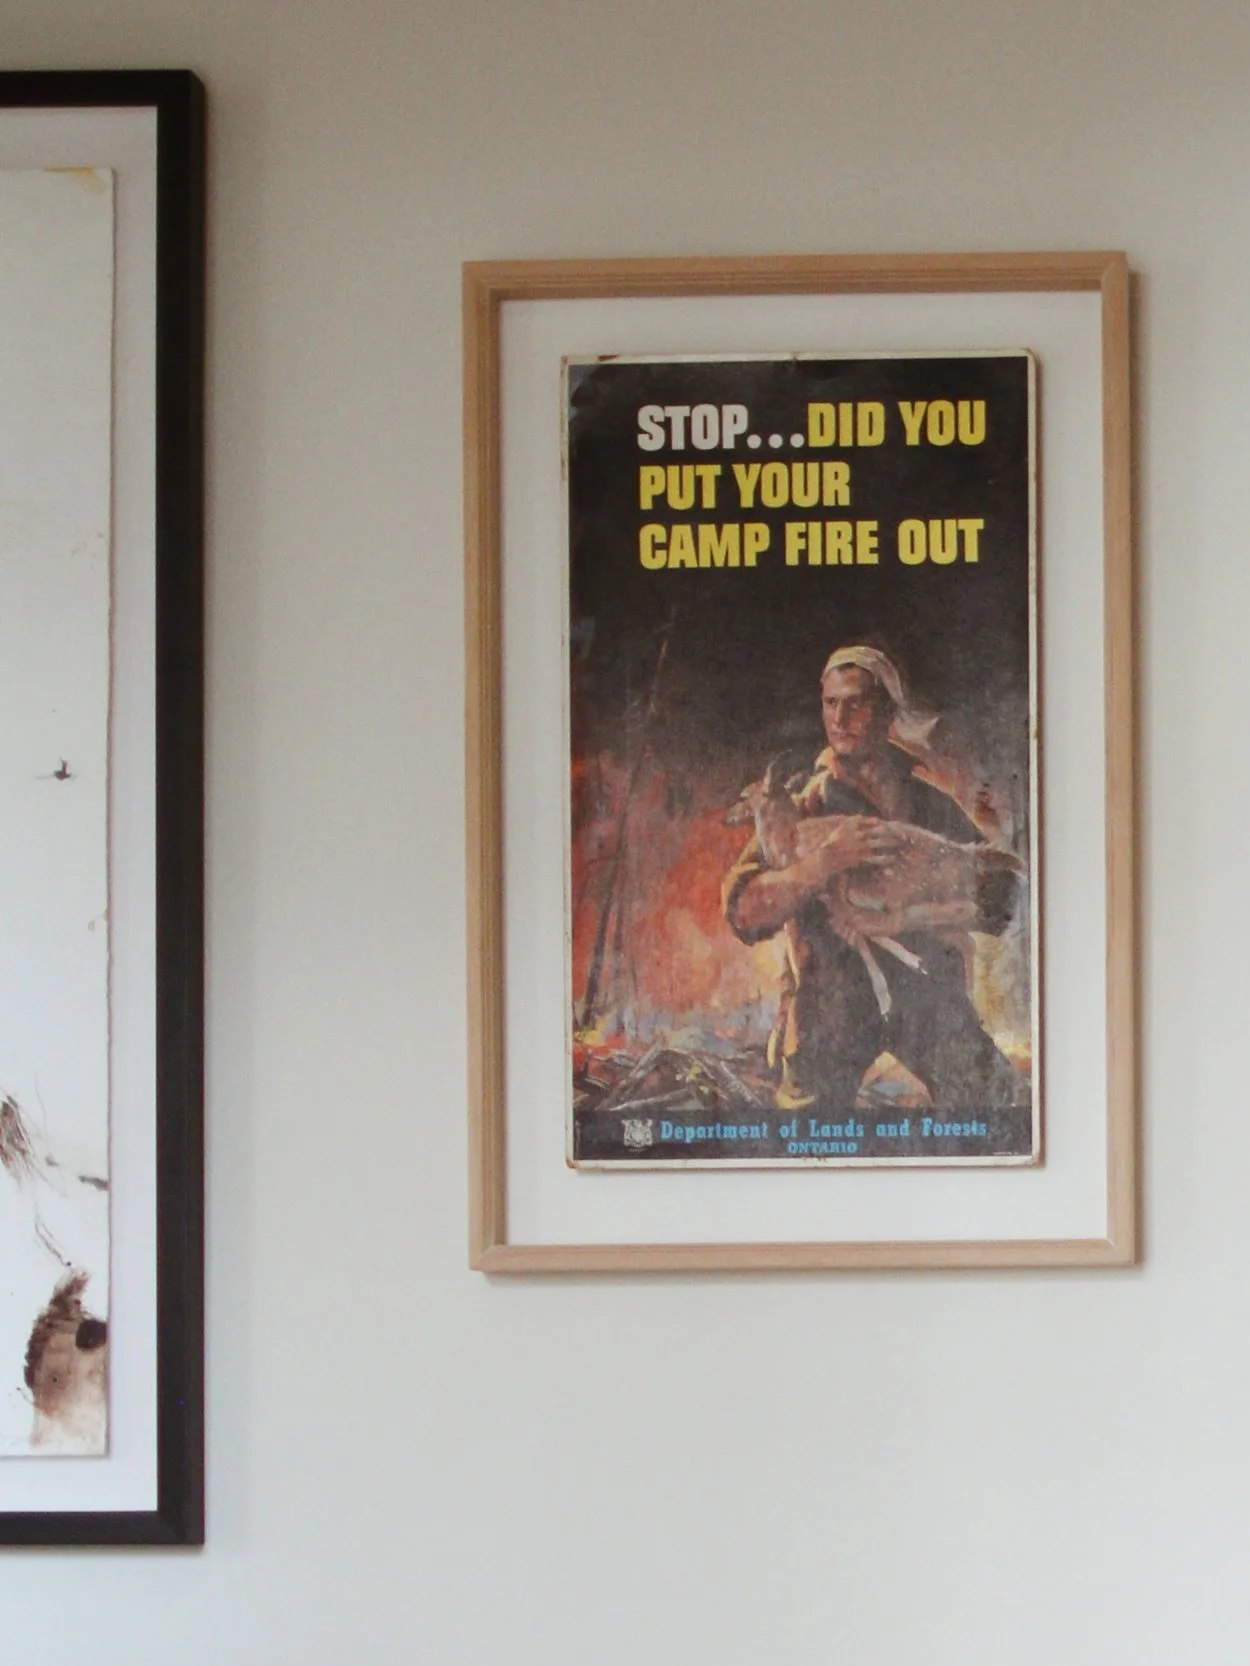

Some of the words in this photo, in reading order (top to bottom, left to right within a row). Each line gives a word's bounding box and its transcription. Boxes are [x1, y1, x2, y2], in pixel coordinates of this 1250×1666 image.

[898, 400, 986, 446] YOU
[639, 464, 721, 510] PUT
[732, 461, 851, 508] YOUR
[639, 522, 770, 569] CAMP
[785, 520, 879, 566] FIRE
[897, 518, 985, 565] OUT
[660, 1120, 769, 1143] Department
[779, 1119, 799, 1138] of
[808, 1118, 865, 1138] Lands
[875, 1118, 911, 1138] and
[921, 1117, 988, 1137] Forests
[786, 1140, 858, 1154] ONTARIO
